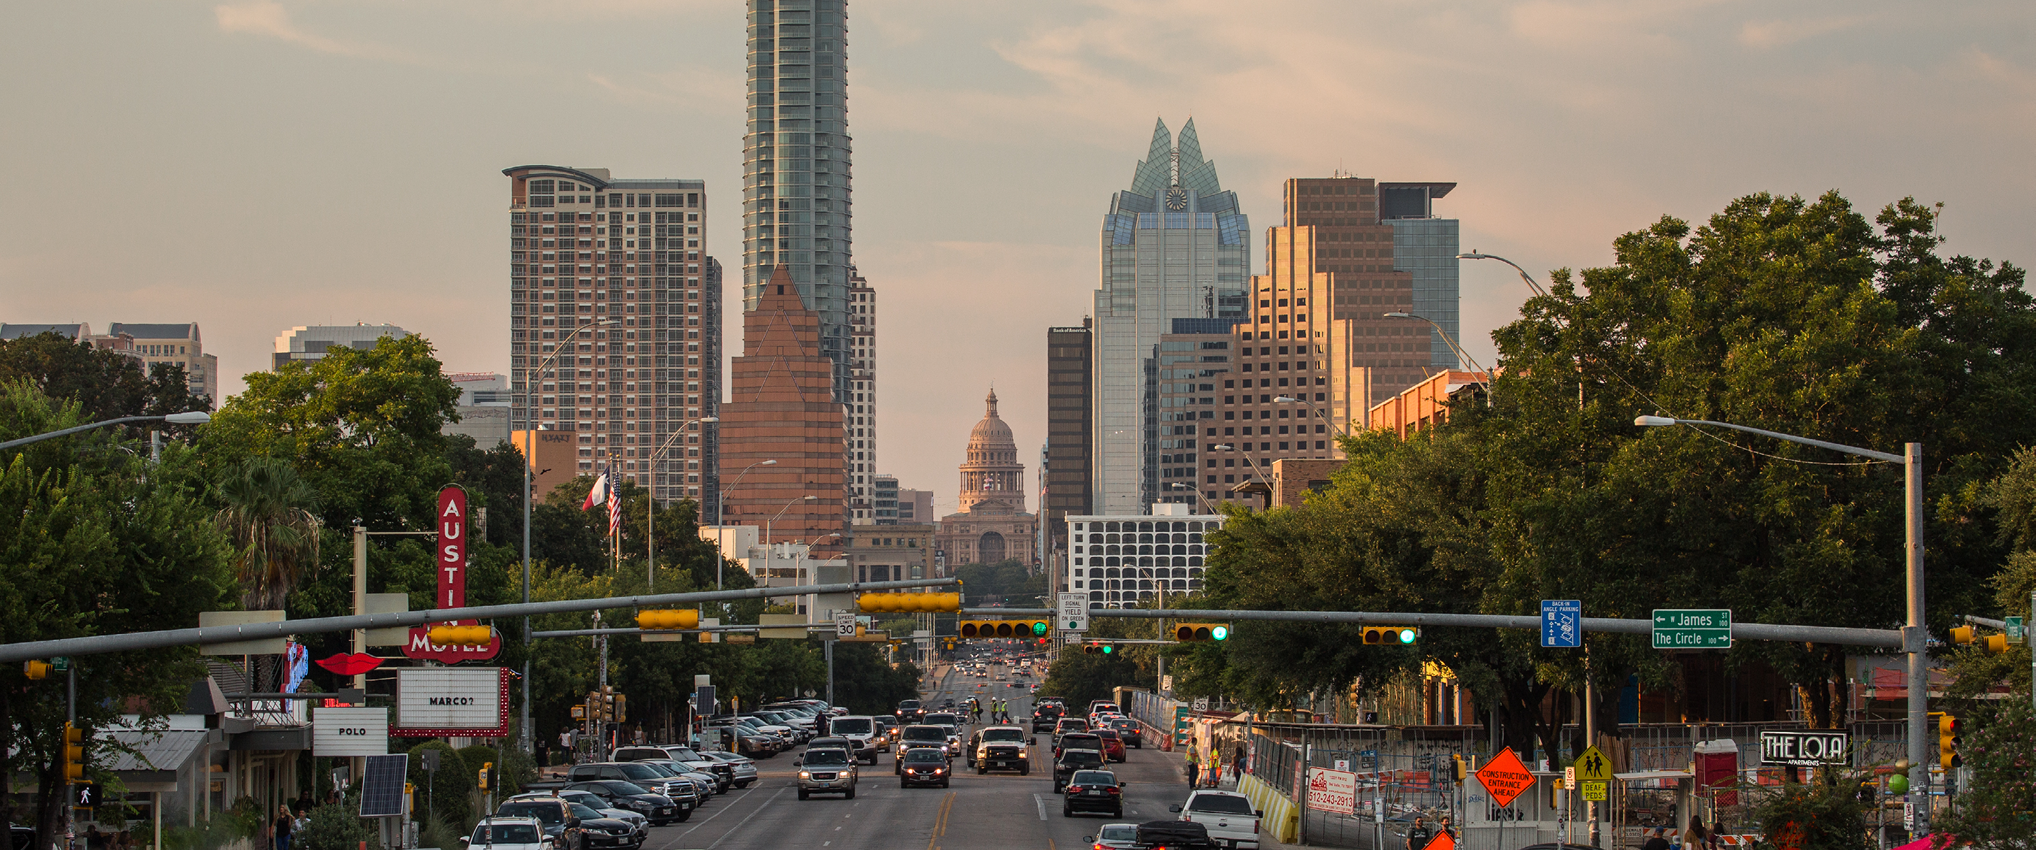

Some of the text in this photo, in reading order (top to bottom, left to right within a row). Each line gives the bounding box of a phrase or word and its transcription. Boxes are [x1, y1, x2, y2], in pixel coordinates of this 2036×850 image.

[542, 434, 570, 443] HYATT
[1678, 613, 1712, 626] James
[840, 625, 853, 634] 30
[1656, 633, 1671, 644] The
[1676, 632, 1701, 644] Circle
[429, 697, 474, 706] MARCO?
[1764, 736, 1842, 759] THE LOLA
[1482, 770, 1530, 781] CONSTRUCTION
[1488, 779, 1521, 789] ENTRANCE
[1494, 788, 1515, 797] AHEAD
[1309, 792, 1352, 807] 512-243-2913
